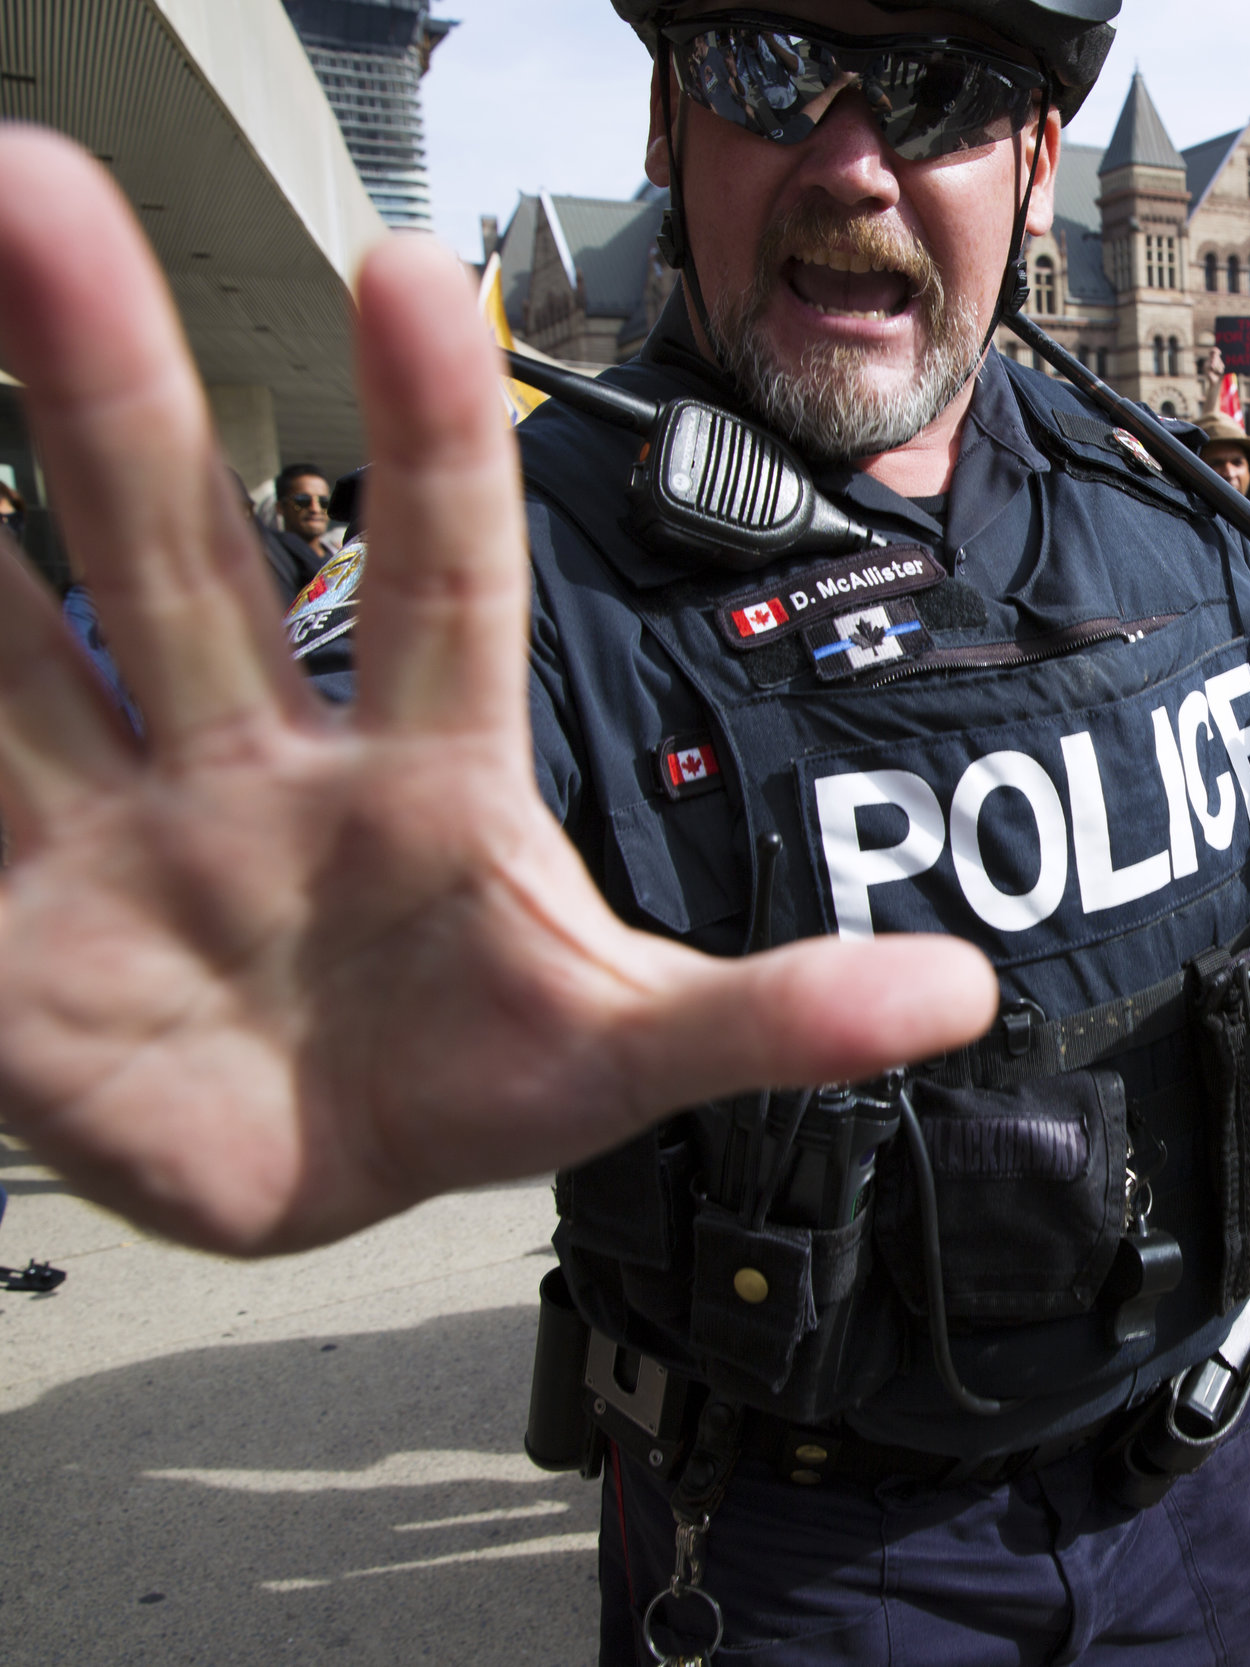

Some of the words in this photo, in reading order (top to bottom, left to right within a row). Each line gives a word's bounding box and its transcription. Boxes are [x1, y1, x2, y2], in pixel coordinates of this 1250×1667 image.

[1215, 331, 1244, 343] FOR
[789, 591, 816, 611] D.
[816, 559, 924, 599] McAllister
[288, 610, 333, 643] ICE
